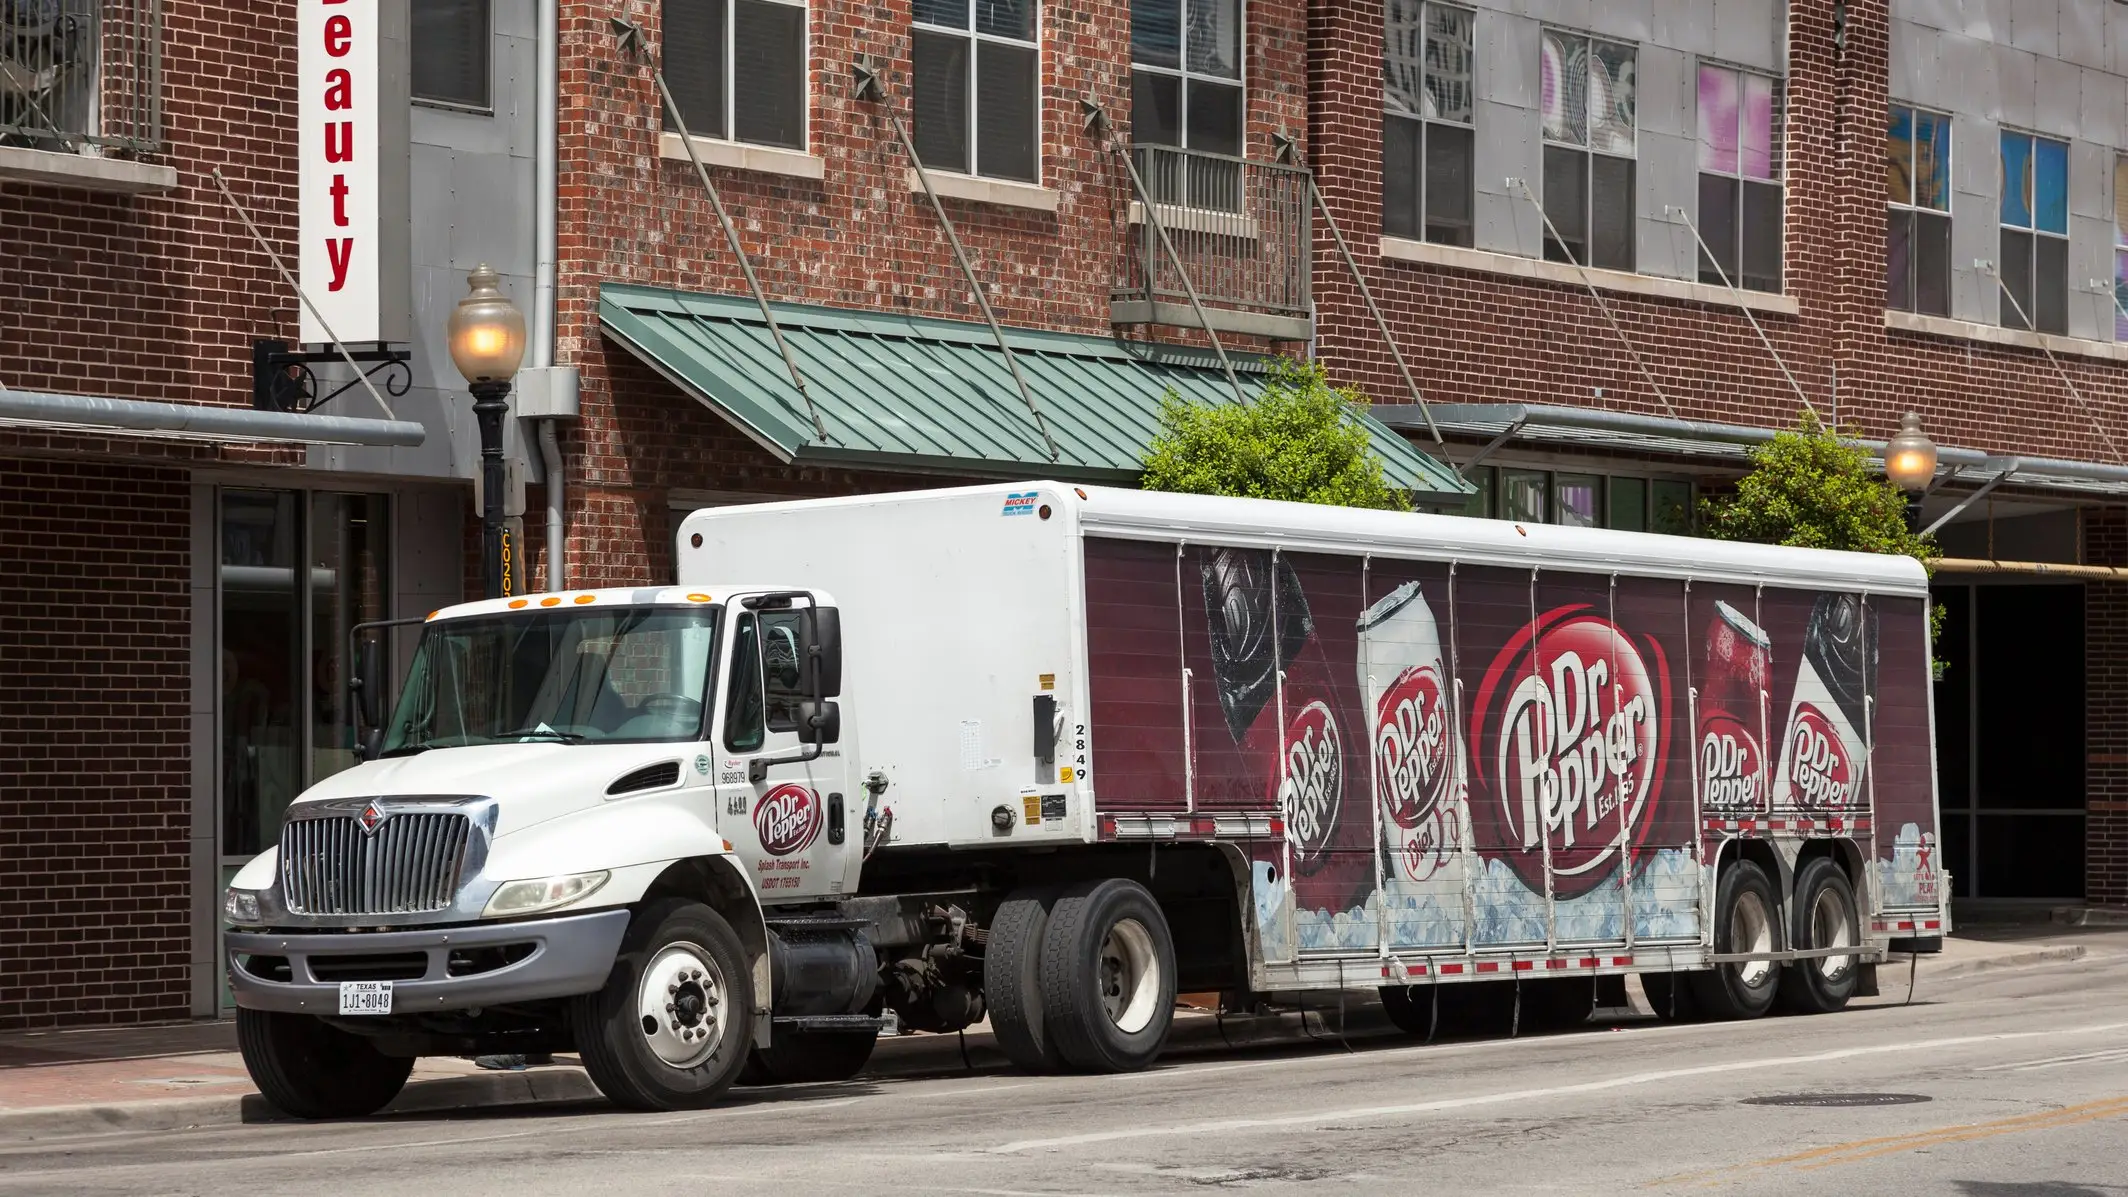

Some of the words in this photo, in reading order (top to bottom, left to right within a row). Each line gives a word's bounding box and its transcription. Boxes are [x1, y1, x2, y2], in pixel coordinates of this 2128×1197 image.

[322, 0, 354, 292] eauty
[1004, 497, 1036, 506] MICKEY
[1396, 690, 1425, 757] Dr
[1551, 650, 1608, 755] Dr
[721, 771, 745, 784] 968979
[1075, 724, 1086, 780] 2849
[1290, 725, 1315, 799] Dr
[1379, 694, 1444, 814] Pepper
[1499, 675, 1645, 853] Pepper
[1702, 732, 1761, 806] Pepper
[1722, 734, 1748, 778] Dr
[1792, 721, 1850, 805] Pepper
[1811, 732, 1840, 778] Dr
[780, 794, 798, 821] Dr
[1278, 718, 1336, 862] Pepper
[762, 800, 811, 845] Pepper
[1408, 821, 1434, 872] Diet
[758, 859, 775, 873] Splash
[775, 859, 800, 872] Transport
[800, 858, 810, 869] Inc.
[761, 877, 780, 889] USDOT
